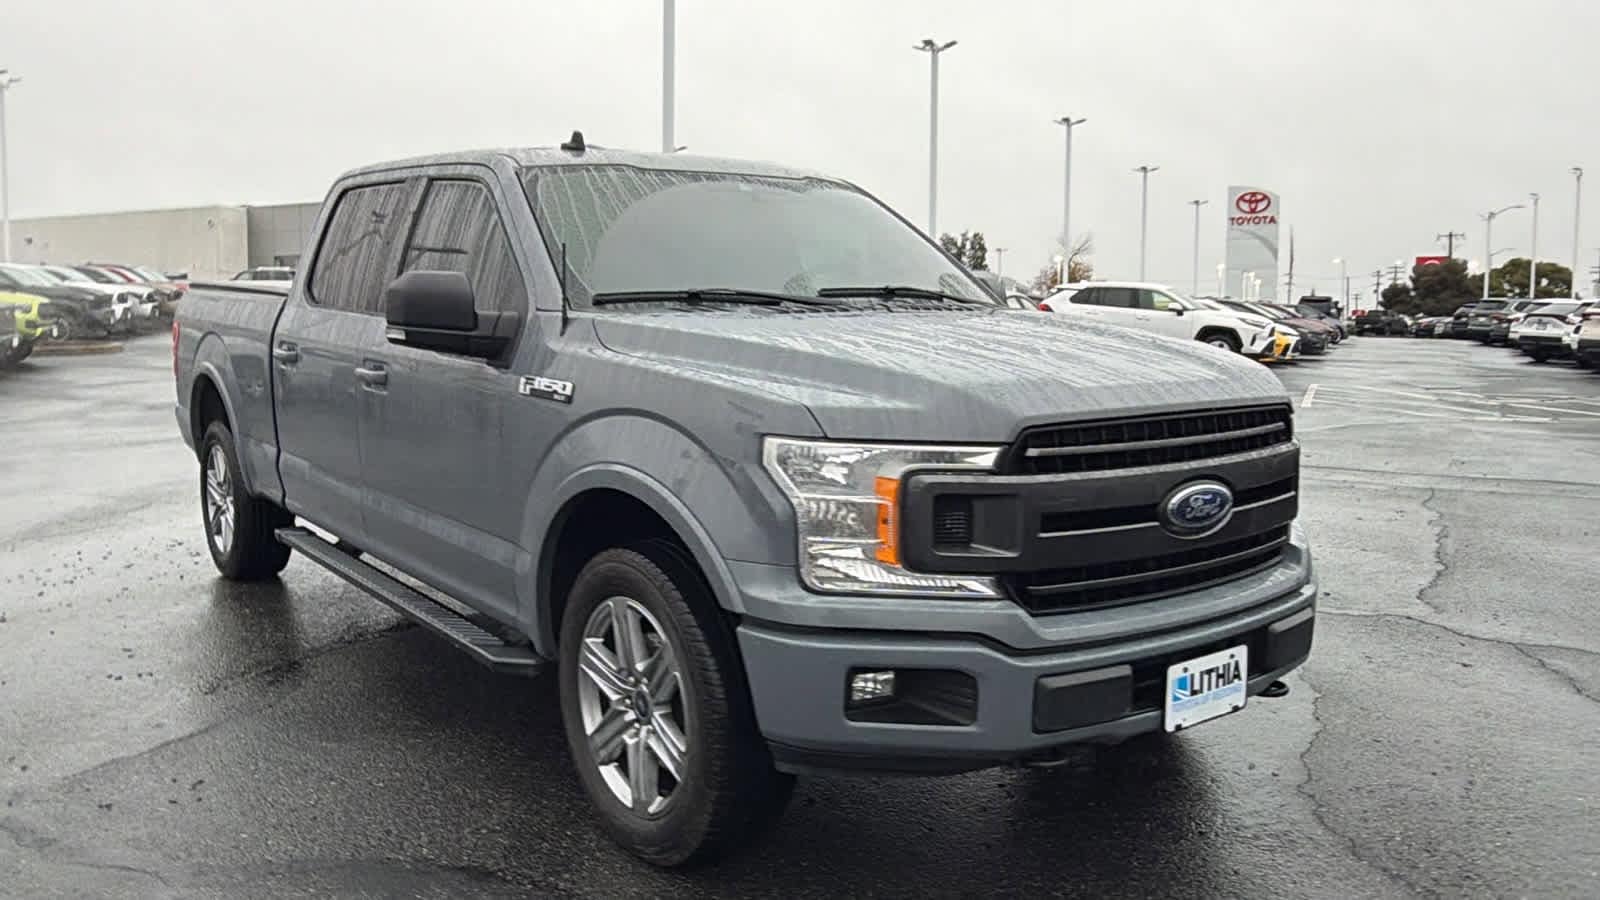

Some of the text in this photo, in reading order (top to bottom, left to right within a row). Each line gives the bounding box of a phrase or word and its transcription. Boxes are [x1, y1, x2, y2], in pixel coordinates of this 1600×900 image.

[1229, 215, 1277, 226] TOYOTA
[1184, 494, 1221, 519] Ford
[1190, 659, 1242, 696] LITHIA
